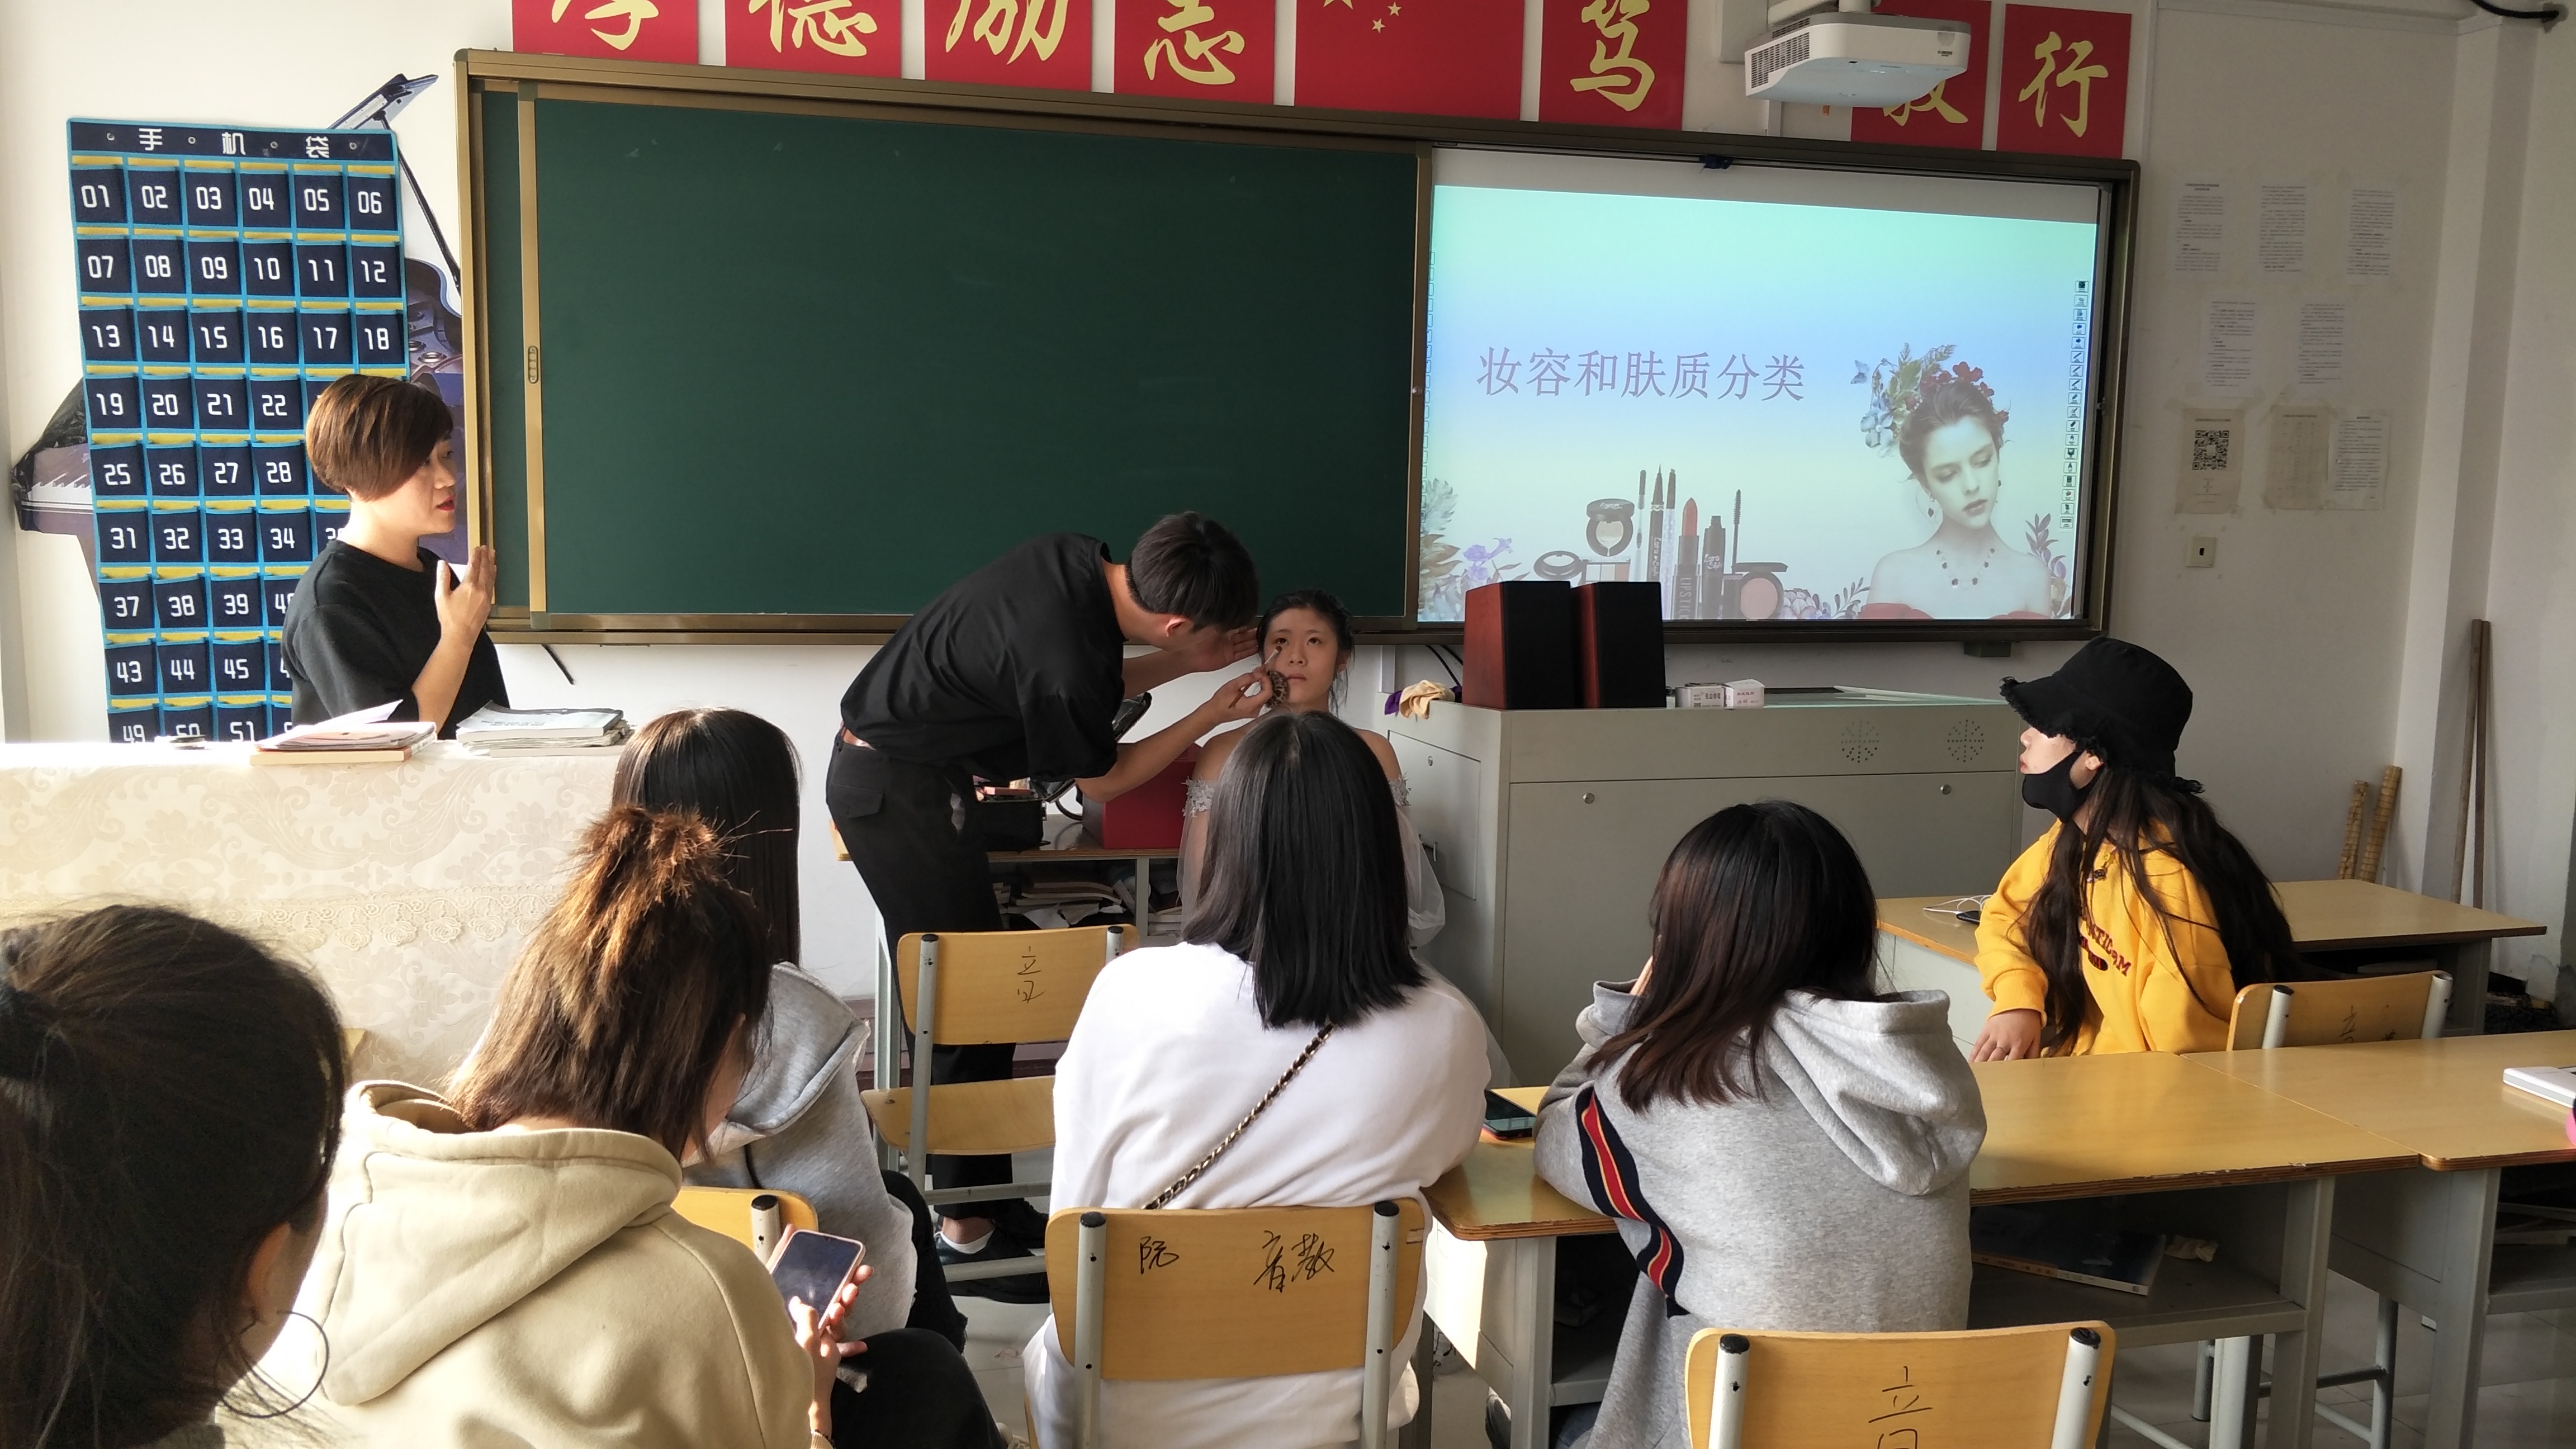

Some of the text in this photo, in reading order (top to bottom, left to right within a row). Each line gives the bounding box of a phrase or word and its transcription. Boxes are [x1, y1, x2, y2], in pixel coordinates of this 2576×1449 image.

[1144, 0, 1245, 85] 志
[1570, 0, 1655, 111] 笃
[2019, 31, 2109, 138] 行
[80, 184, 382, 214] 01 02 03 04 05 06
[87, 255, 386, 283] 07 08 09 10 11 12
[92, 325, 390, 350] 13 14 15 16 17 18
[1476, 347, 1805, 401] 妆容和肤质分类
[96, 392, 287, 416] 19 20 21 22
[103, 461, 292, 485] 25 26 27 28
[110, 527, 136, 549] 31
[163, 527, 190, 550] 32
[217, 528, 244, 550] 33
[270, 528, 295, 549] 34
[113, 596, 139, 617] 37
[168, 595, 195, 617] 38
[223, 593, 249, 615] 39
[117, 661, 142, 683] 43
[171, 659, 195, 681] 44
[224, 659, 249, 679] 45
[122, 724, 146, 744] 49
[230, 721, 255, 742] 51
